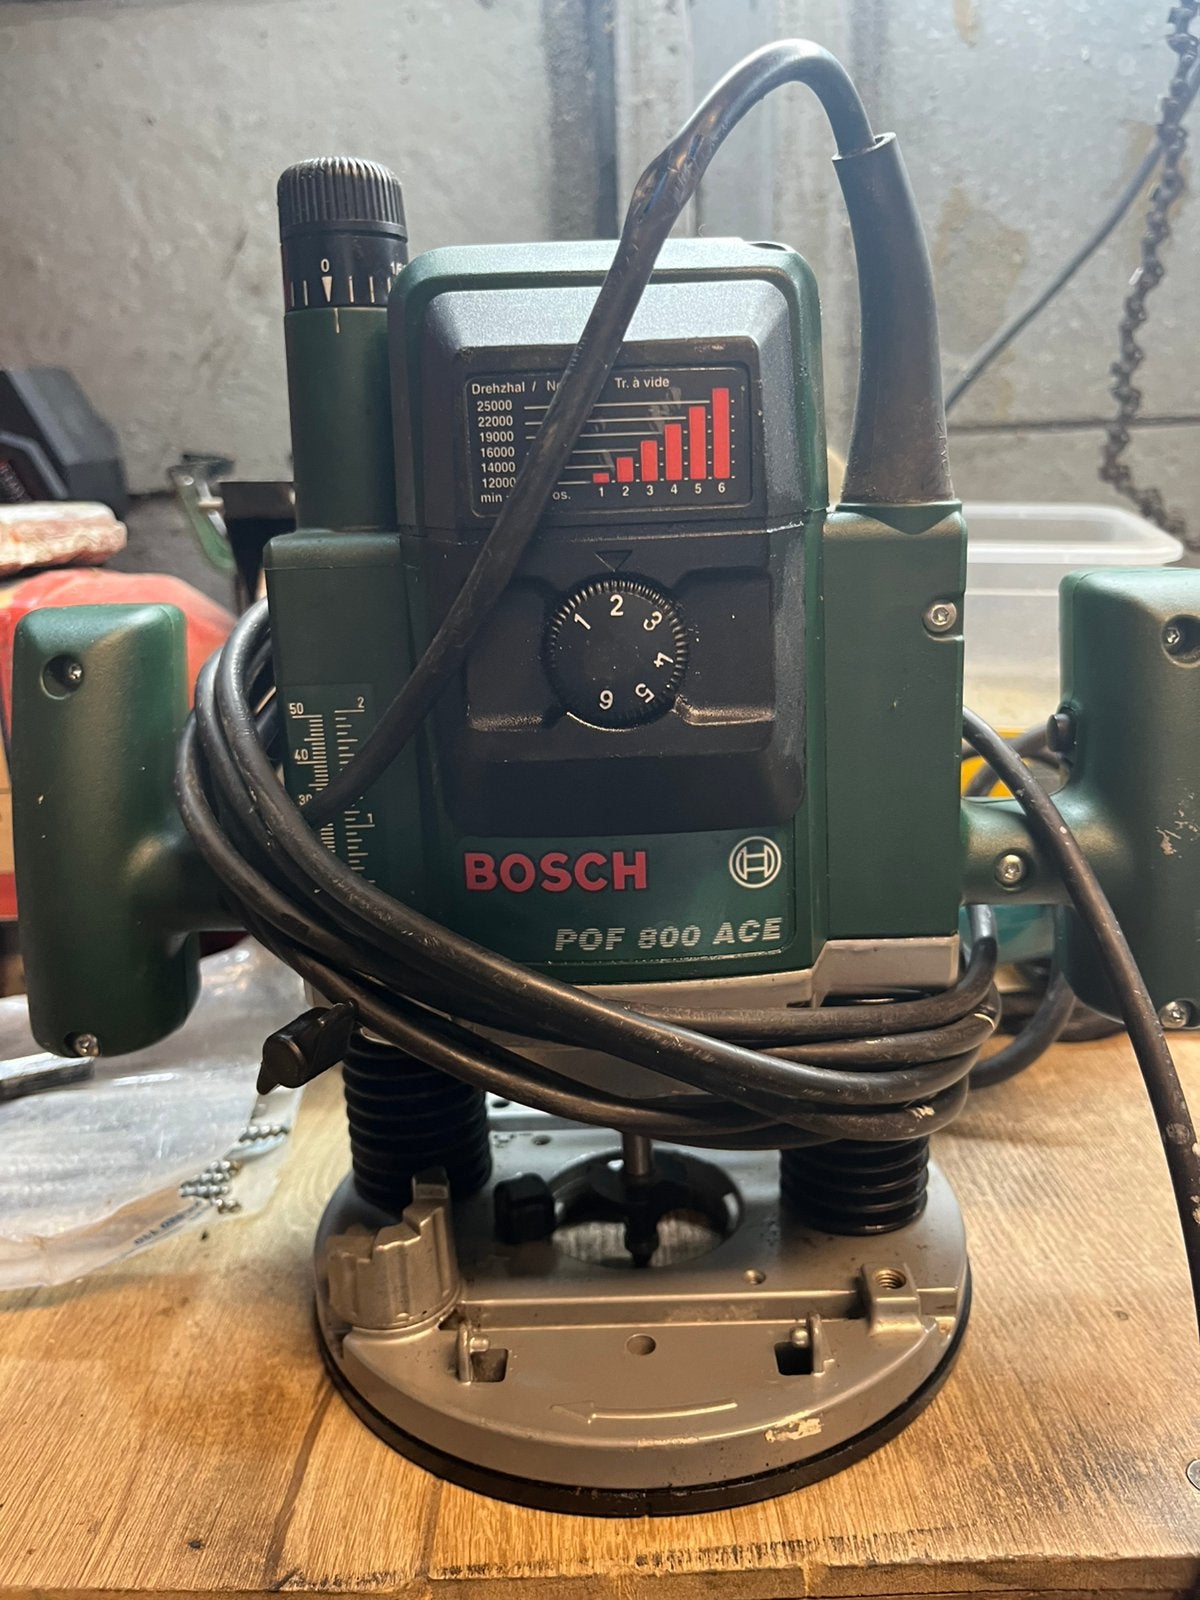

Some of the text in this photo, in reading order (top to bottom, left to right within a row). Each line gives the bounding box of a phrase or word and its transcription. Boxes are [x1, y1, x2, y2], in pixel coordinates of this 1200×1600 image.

[320, 258, 330, 272] 0
[471, 381, 525, 395] Drehzhal
[614, 377, 629, 389] Tr.
[632, 376, 640, 388] à
[643, 376, 670, 388] vide
[476, 400, 513, 412] 25000
[477, 415, 514, 427] 22000
[479, 431, 515, 443] 19000
[480, 446, 516, 458] 16000
[481, 461, 516, 473] 14000
[482, 477, 516, 488] 12000
[480, 492, 503, 503] min
[552, 482, 726, 501] os. 1 2 3 4 5 6
[609, 594, 624, 616] 2
[574, 613, 591, 630] 1
[643, 611, 663, 631] 3
[653, 652, 674, 668] 4
[635, 683, 655, 703] 5
[357, 697, 365, 708] 2
[599, 690, 613, 710] 6
[289, 703, 304, 715] 50
[294, 749, 309, 761] 40
[367, 813, 373, 824] 1
[464, 851, 647, 892] BOSCH
[555, 917, 783, 951] POF 800 ACE
